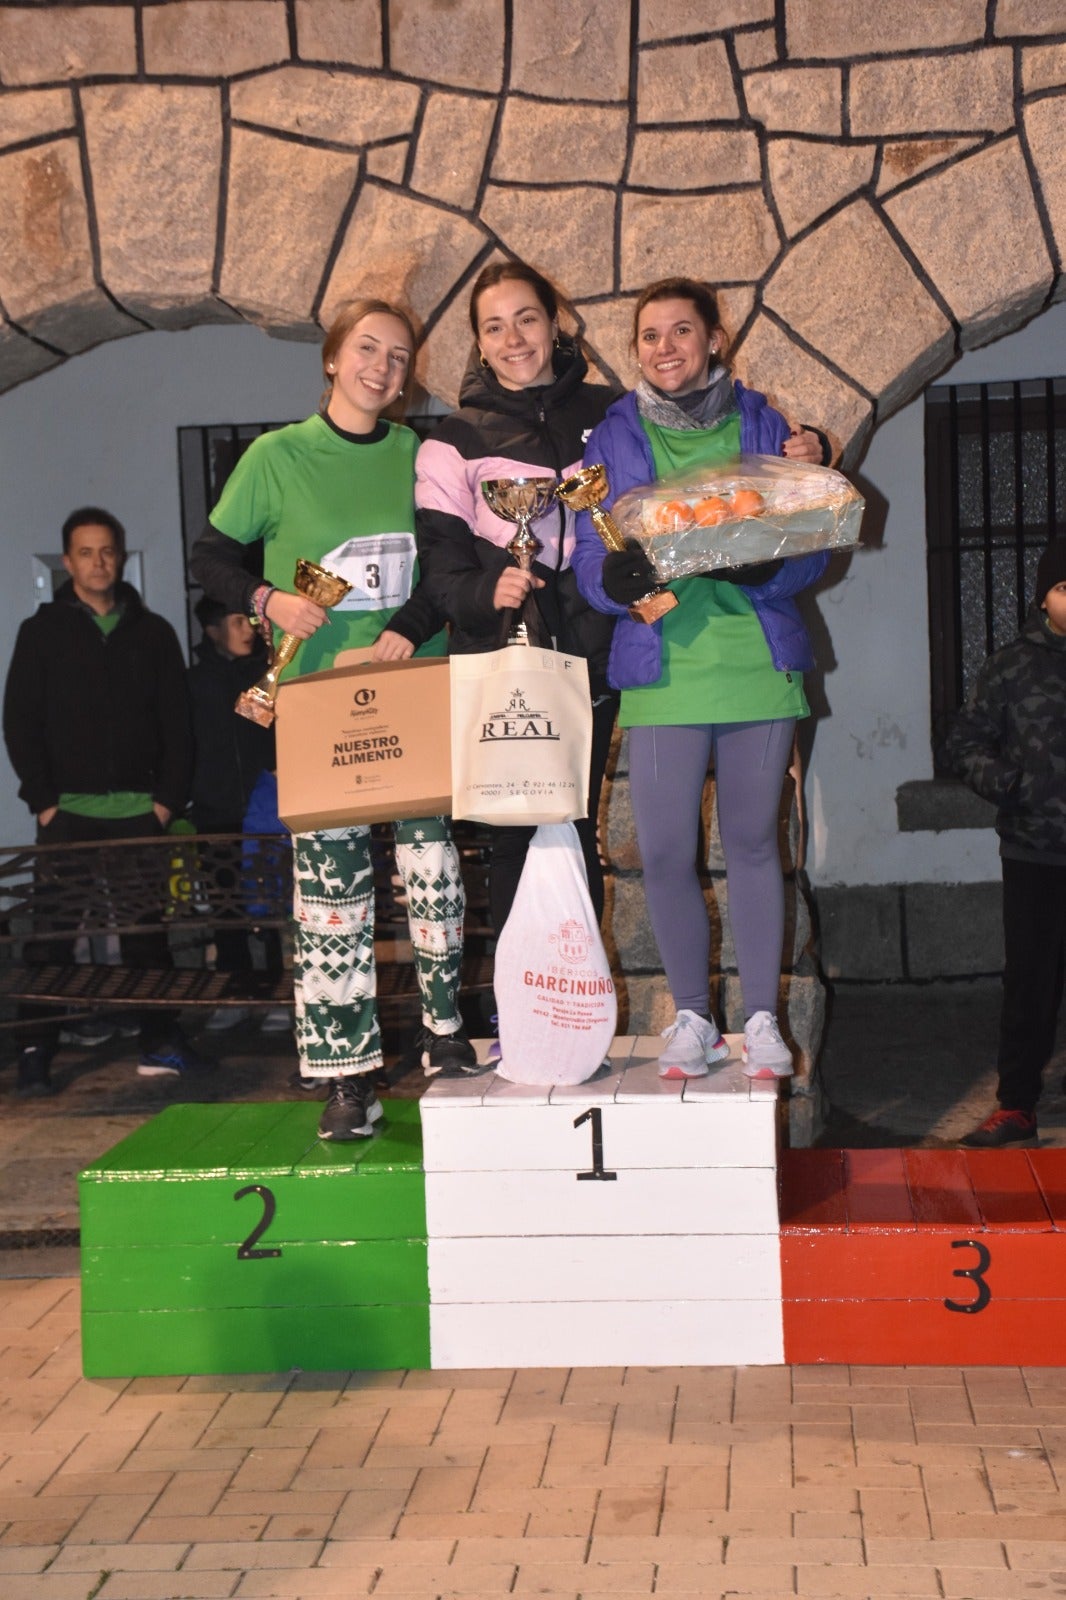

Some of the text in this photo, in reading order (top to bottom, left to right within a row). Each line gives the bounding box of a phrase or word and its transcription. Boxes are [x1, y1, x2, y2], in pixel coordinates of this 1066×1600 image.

[365, 563, 380, 589] 3
[481, 720, 560, 738] REAL
[331, 747, 403, 767] ALIMENTO
[333, 735, 400, 754] NUESTRO
[524, 971, 613, 996] GARCINUÑO
[537, 994, 564, 1005] CALIDAD
[574, 1107, 617, 1181] 1
[234, 1184, 282, 1260] 2
[944, 1240, 991, 1314] 3
